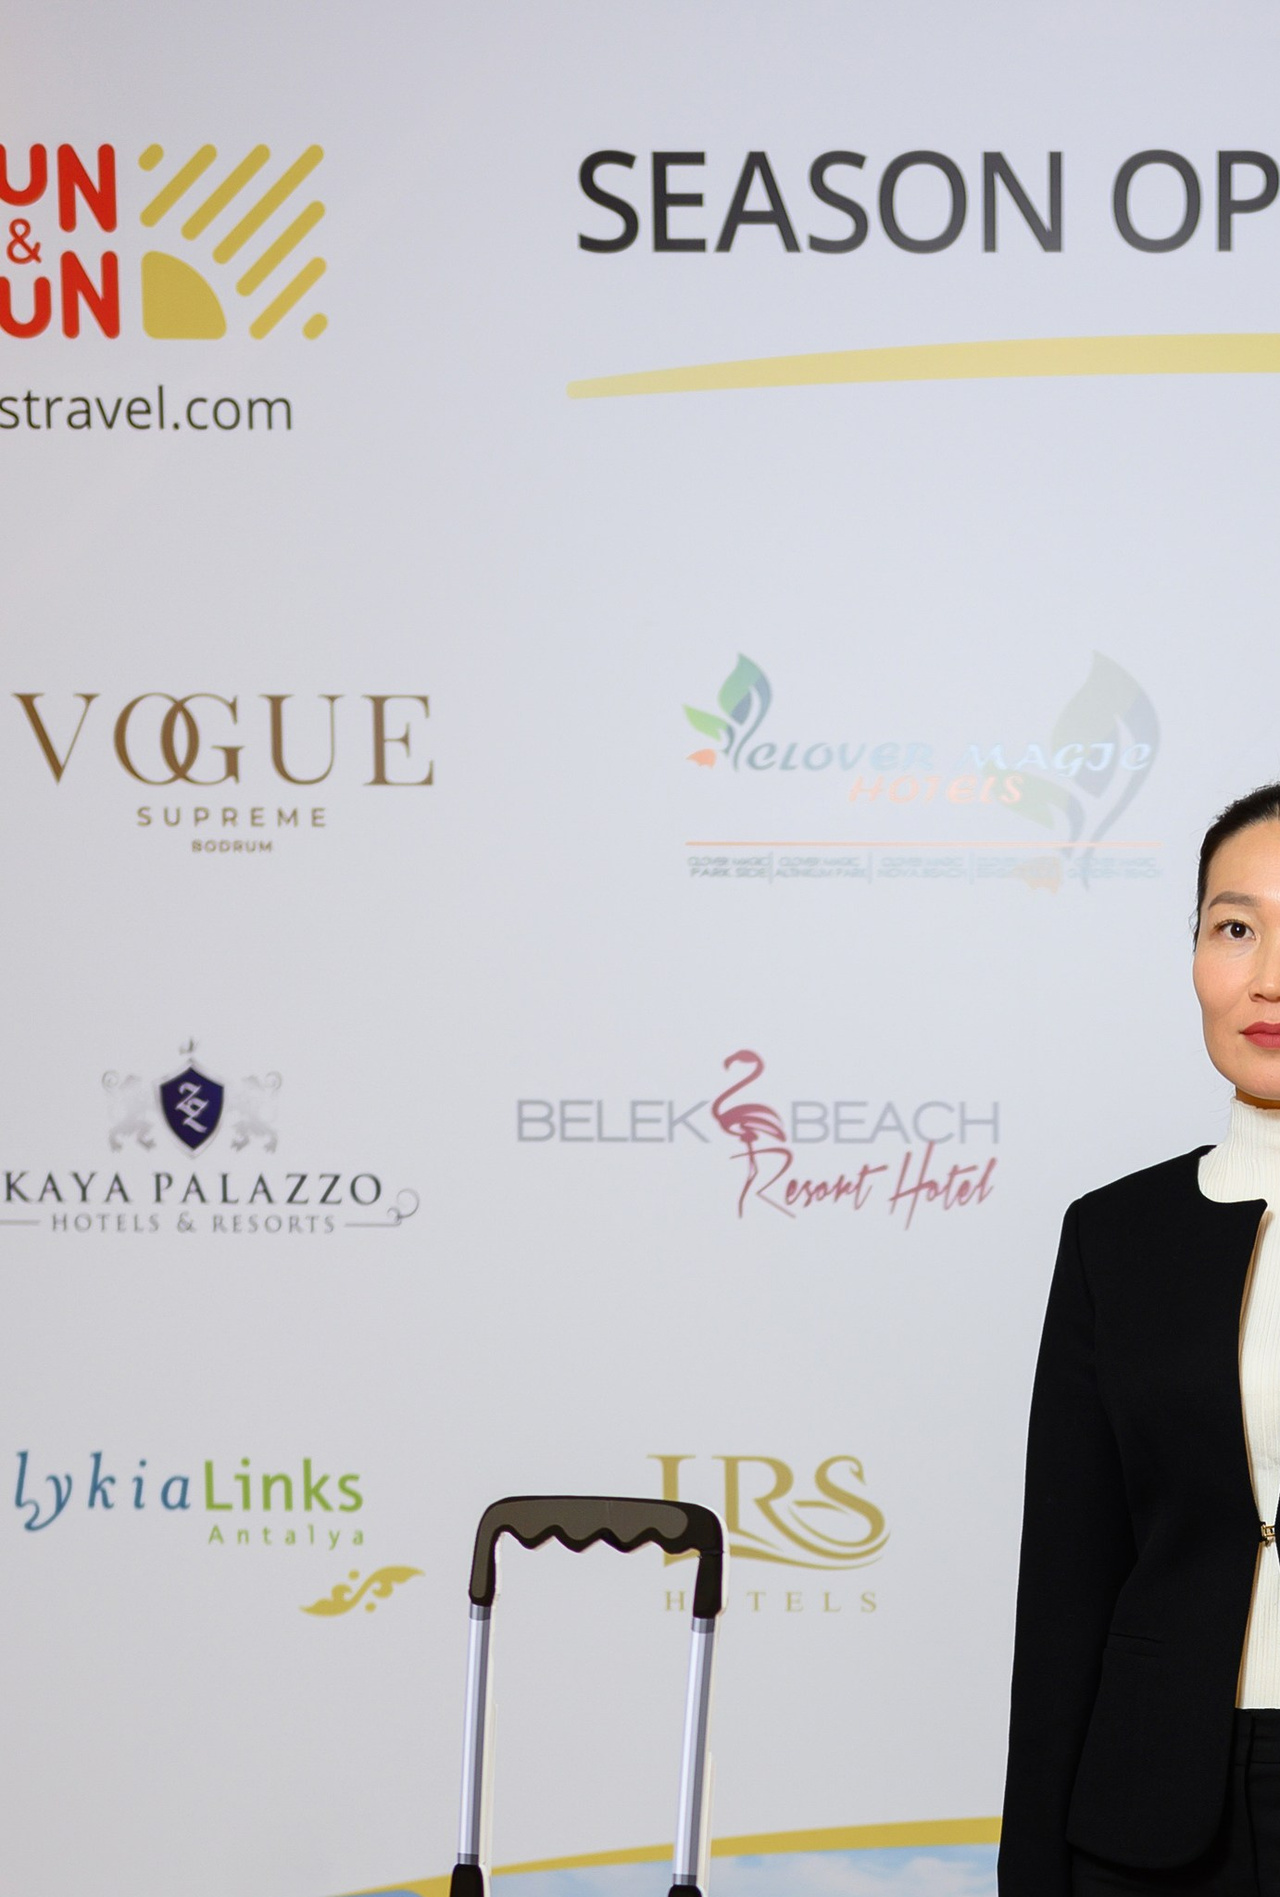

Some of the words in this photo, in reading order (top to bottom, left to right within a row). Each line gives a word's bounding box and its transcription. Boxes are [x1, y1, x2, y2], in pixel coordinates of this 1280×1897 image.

[576, 150, 1063, 255] SEASON
[6, 218, 42, 265] &
[11, 692, 434, 787] VOGUE
[747, 742, 935, 772] CLOVER
[955, 742, 1153, 778] MAGIC
[848, 774, 1025, 805] HOTELS
[136, 806, 328, 829] SUPREME
[191, 839, 274, 854] BODRUM
[515, 1099, 712, 1144] BELEK
[789, 1100, 1000, 1144] BEACH
[2, 1171, 131, 1203] KAYA
[153, 1172, 383, 1207] PALAZZO
[888, 1141, 998, 1231] Hotel
[51, 1212, 161, 1233] HOTELS
[176, 1213, 197, 1233] &
[211, 1213, 336, 1235] RESORTS
[207, 1523, 365, 1550] Antalya
[663, 1590, 878, 1614] HTELS
